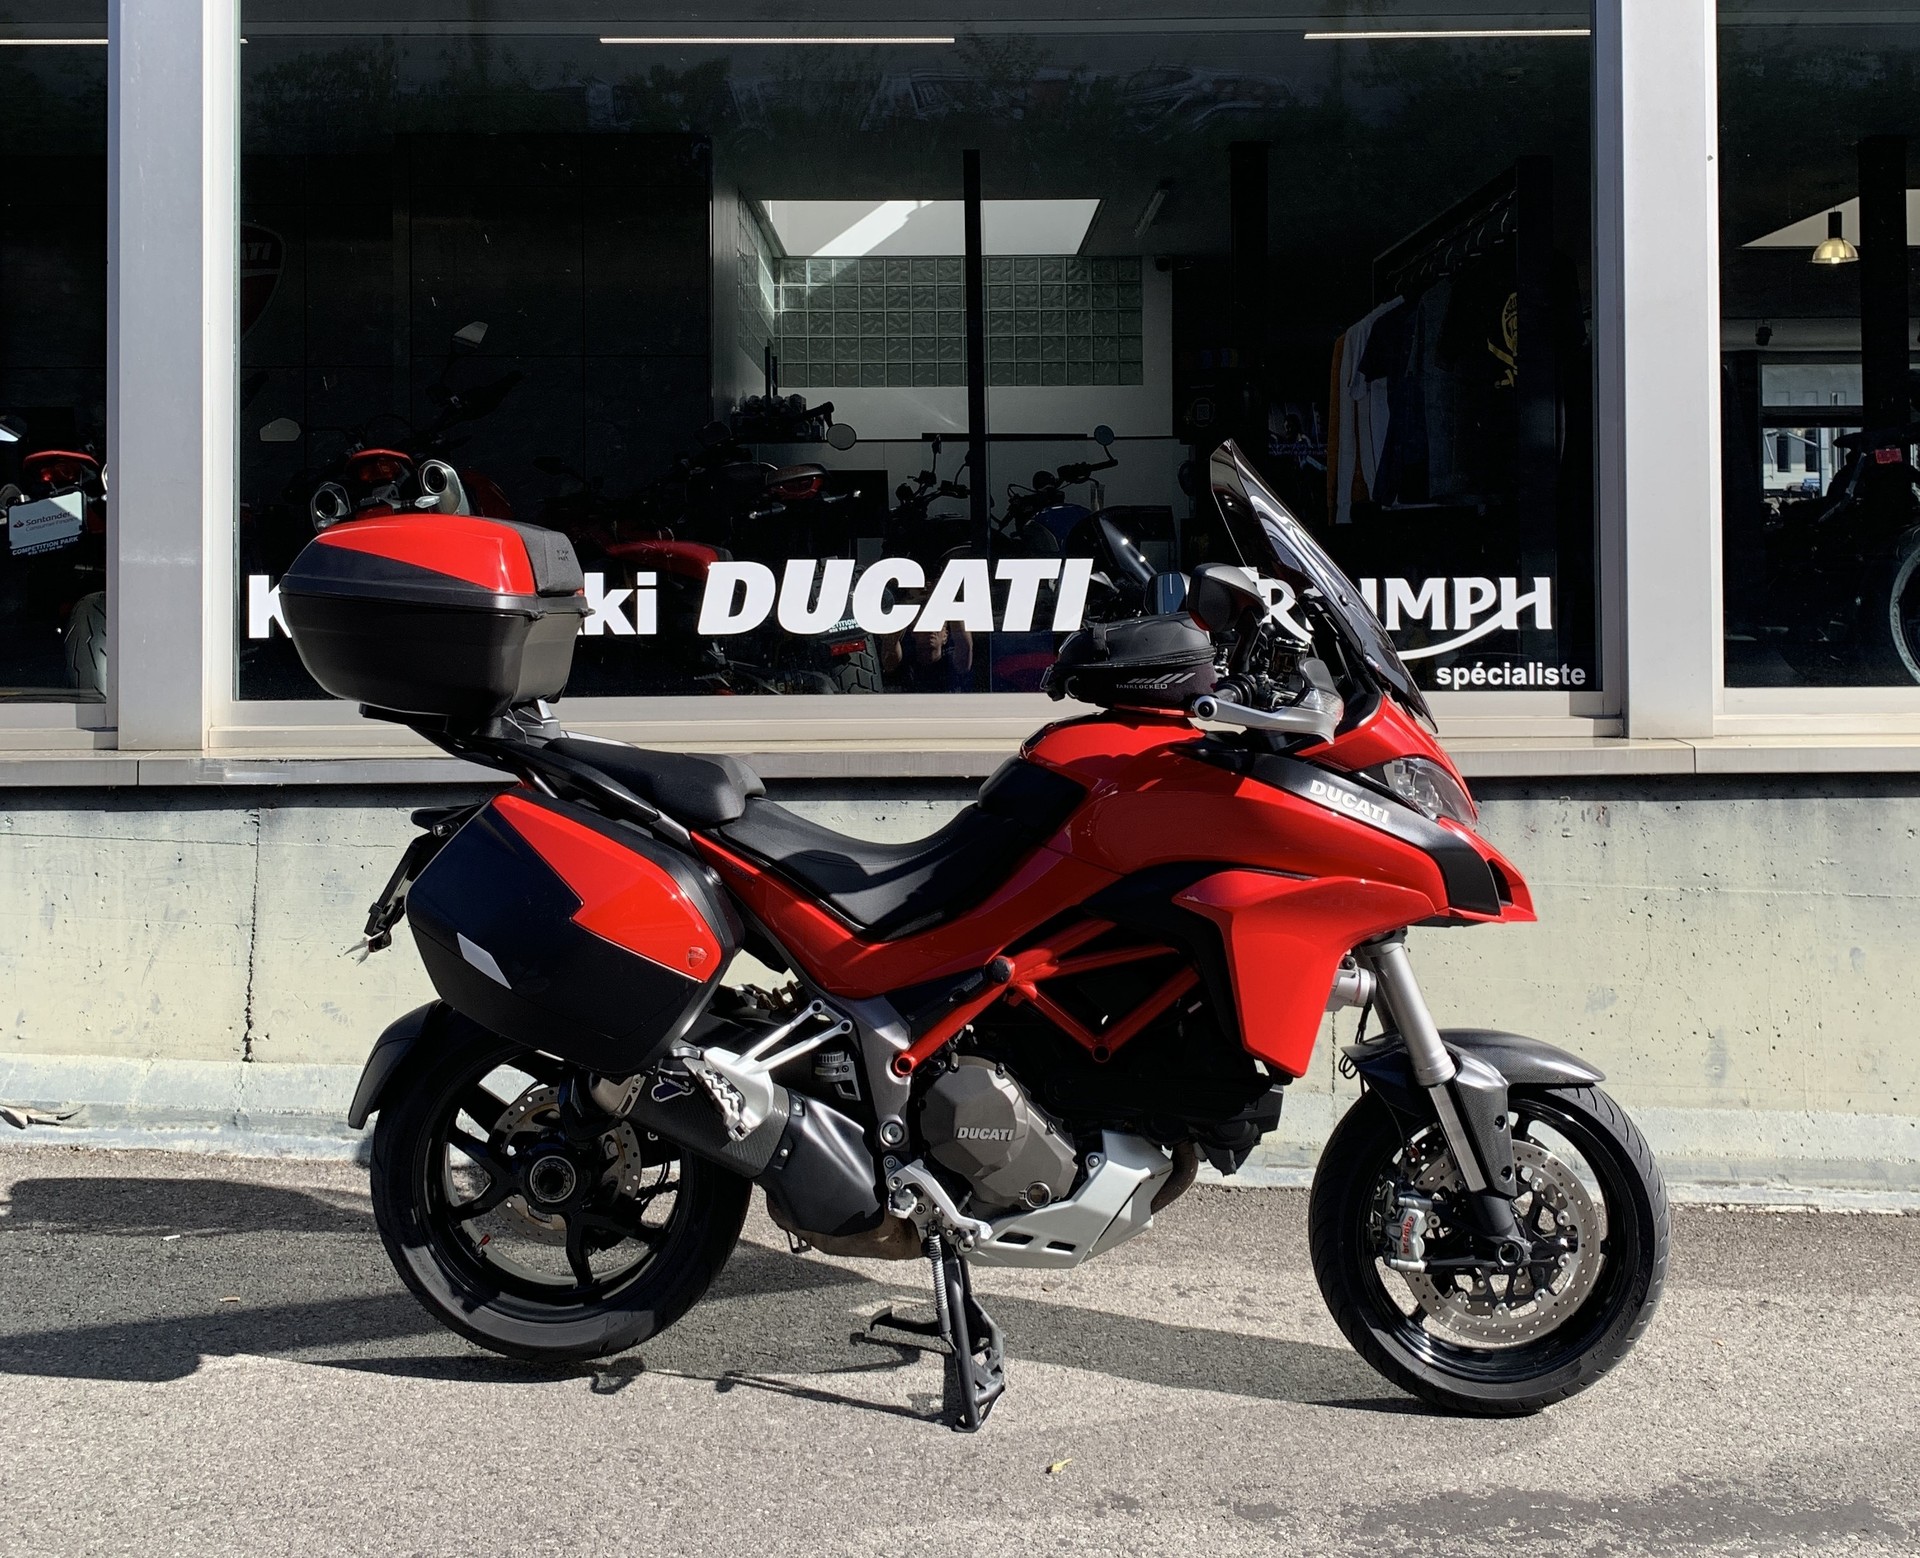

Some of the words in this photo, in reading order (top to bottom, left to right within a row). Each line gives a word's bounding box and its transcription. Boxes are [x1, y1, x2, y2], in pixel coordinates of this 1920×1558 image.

[26, 512, 71, 525] Santander
[12, 541, 59, 556] COMPETITION
[60, 536, 79, 545] PARK
[698, 558, 1094, 635] DUCATI
[1239, 566, 1553, 661] RMPH
[1436, 661, 1586, 690] spécialiste
[1309, 779, 1390, 824] DUCATI
[957, 1127, 1015, 1141] DUCATI
[1402, 1215, 1414, 1254] brembo
